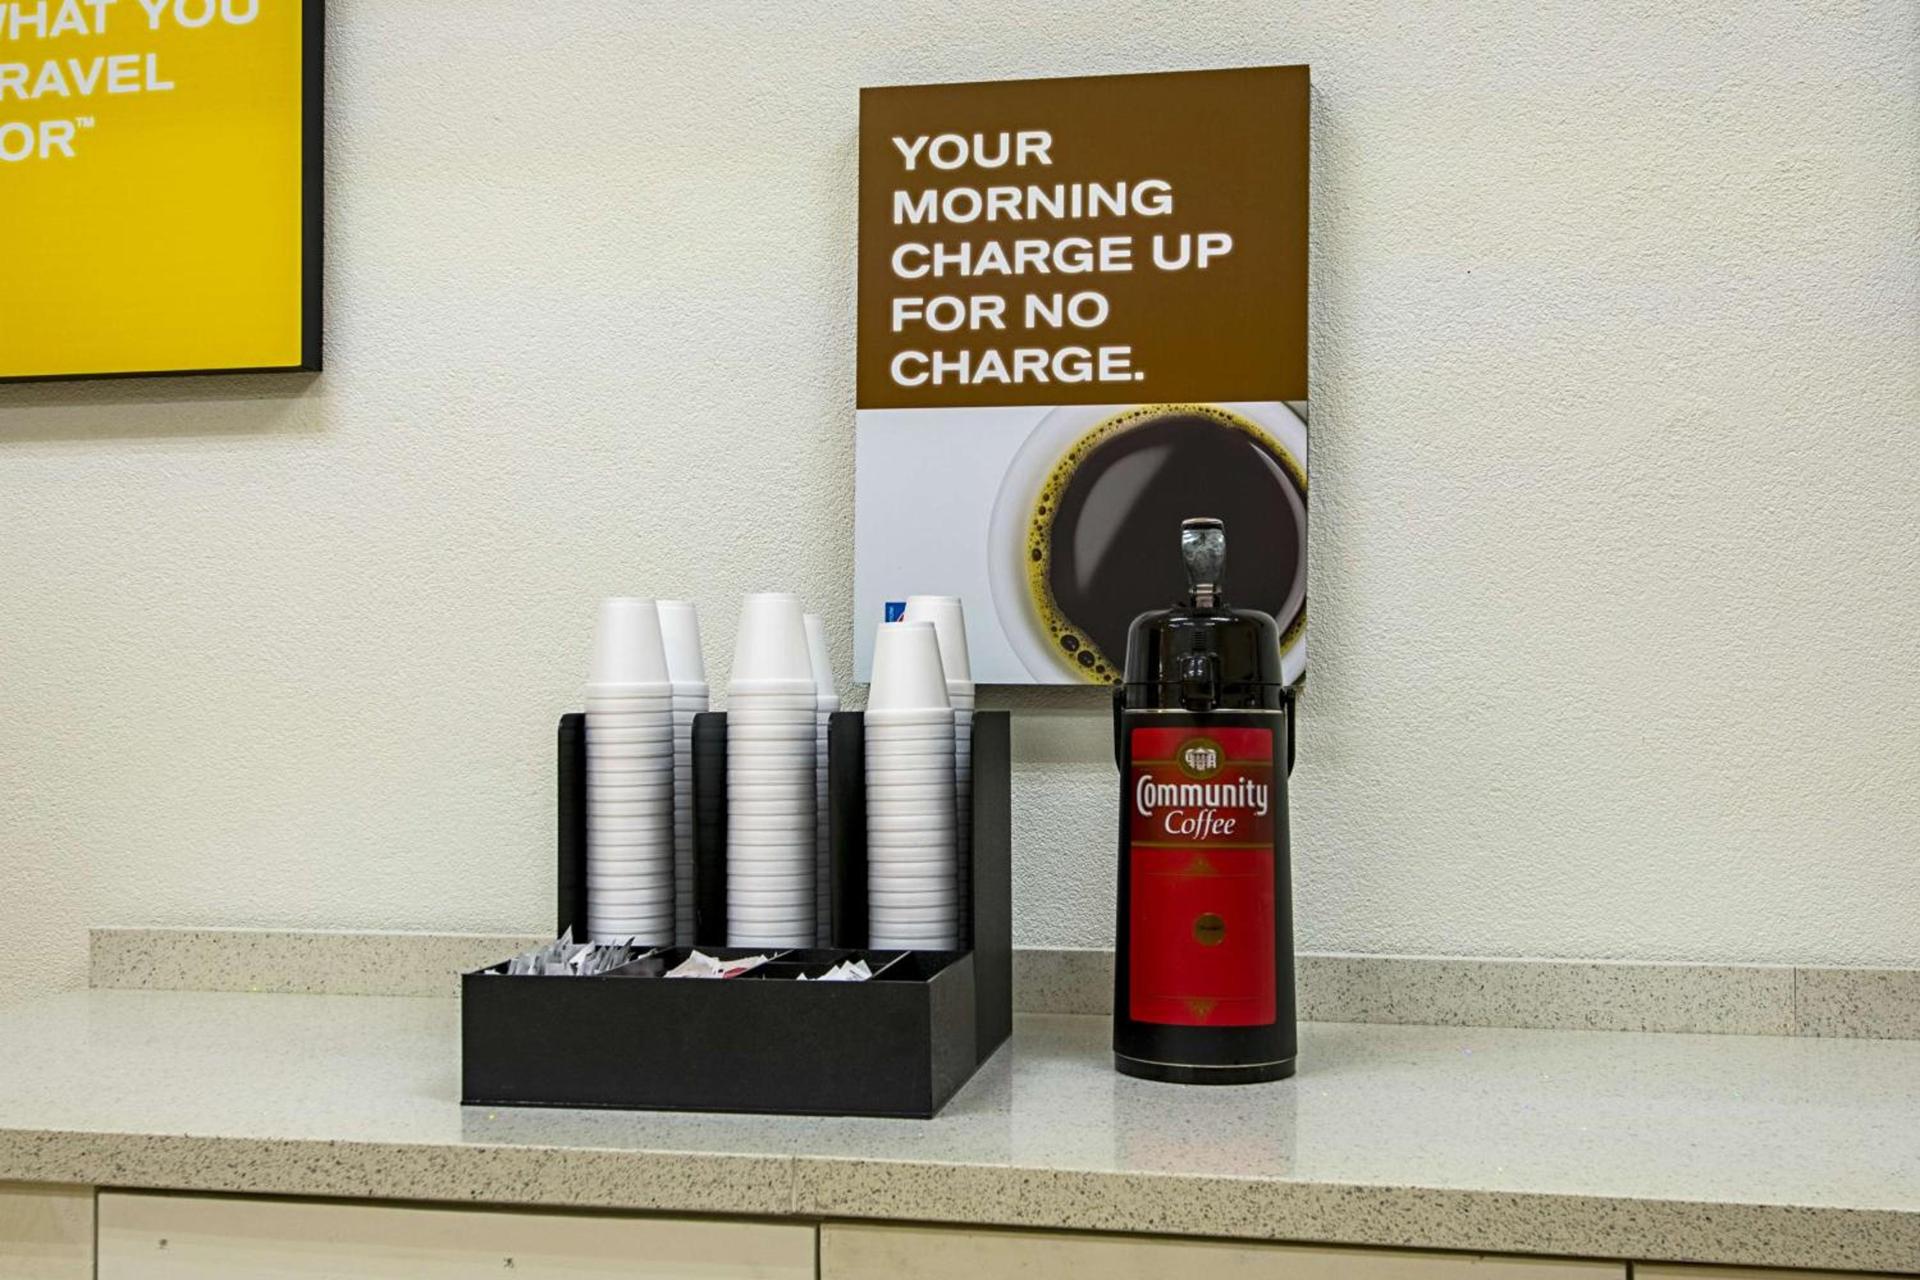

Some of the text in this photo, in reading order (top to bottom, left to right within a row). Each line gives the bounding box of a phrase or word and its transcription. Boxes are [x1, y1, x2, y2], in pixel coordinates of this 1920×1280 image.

[0, 0, 260, 40] HAT YOU
[0, 53, 175, 101] RAVEL
[891, 130, 1053, 171] YOUR
[892, 178, 1173, 225] MORNING
[890, 232, 1234, 279] CHARGE UP
[891, 291, 1111, 333] FOR NO
[889, 345, 1146, 387] CHARGE.
[1136, 774, 1268, 816] Community
[1164, 808, 1236, 840] Coffee
